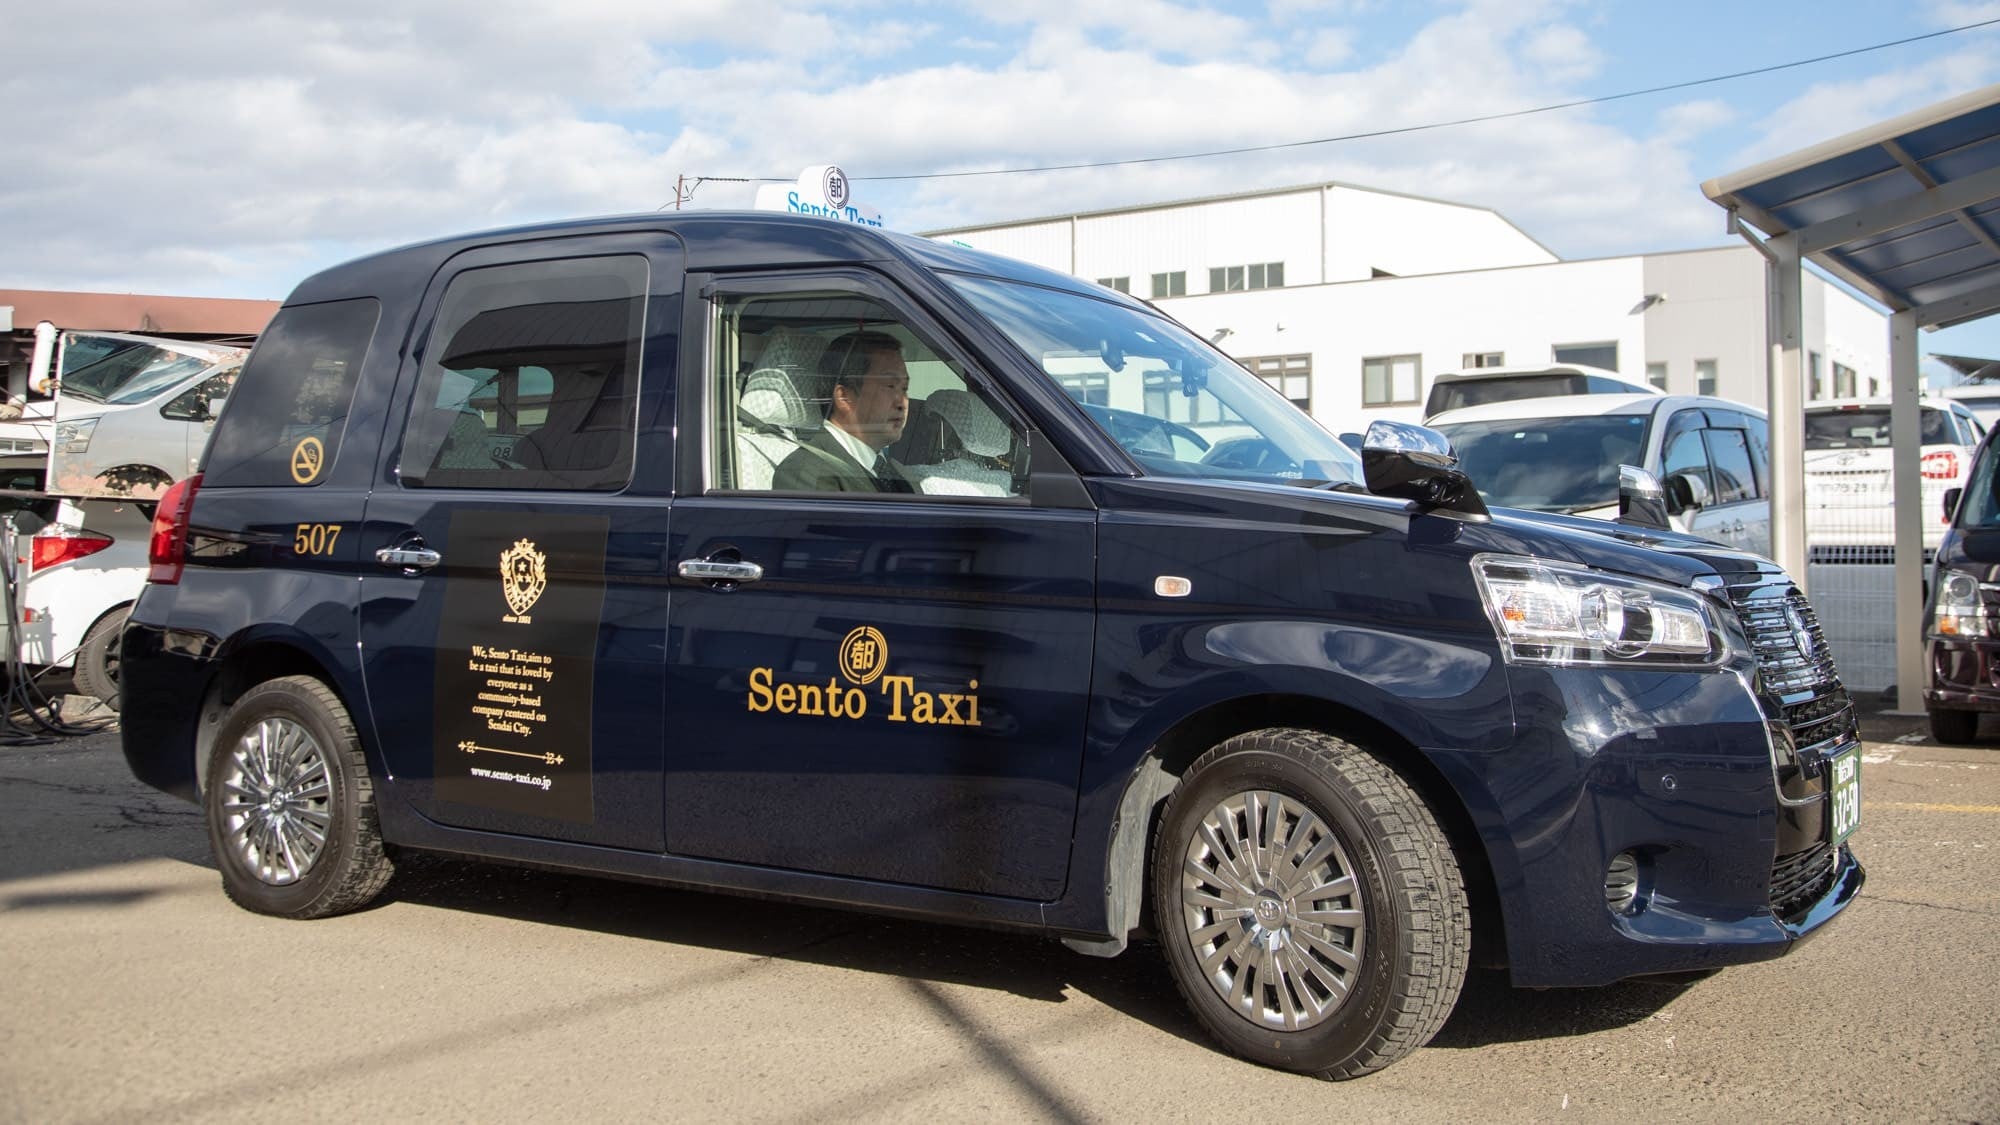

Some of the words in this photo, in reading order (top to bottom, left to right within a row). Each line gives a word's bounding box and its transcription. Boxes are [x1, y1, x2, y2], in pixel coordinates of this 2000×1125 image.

[294, 524, 342, 555] 507
[488, 648, 509, 659] Sento
[543, 655, 552, 664] to
[851, 640, 876, 670] 都
[469, 660, 478, 671] be
[485, 663, 498, 673] taxi
[499, 664, 514, 675] that
[515, 667, 521, 675] is
[523, 666, 542, 678] loved
[543, 668, 553, 682] by
[487, 679, 517, 691] everyone
[748, 667, 867, 719] Sento
[882, 675, 982, 726] Taxi
[472, 706, 504, 719] company
[505, 710, 535, 720] centered
[536, 714, 546, 722] on
[488, 719, 512, 732] Sendai
[471, 767, 552, 789] www.sento-taxi.co.jp
